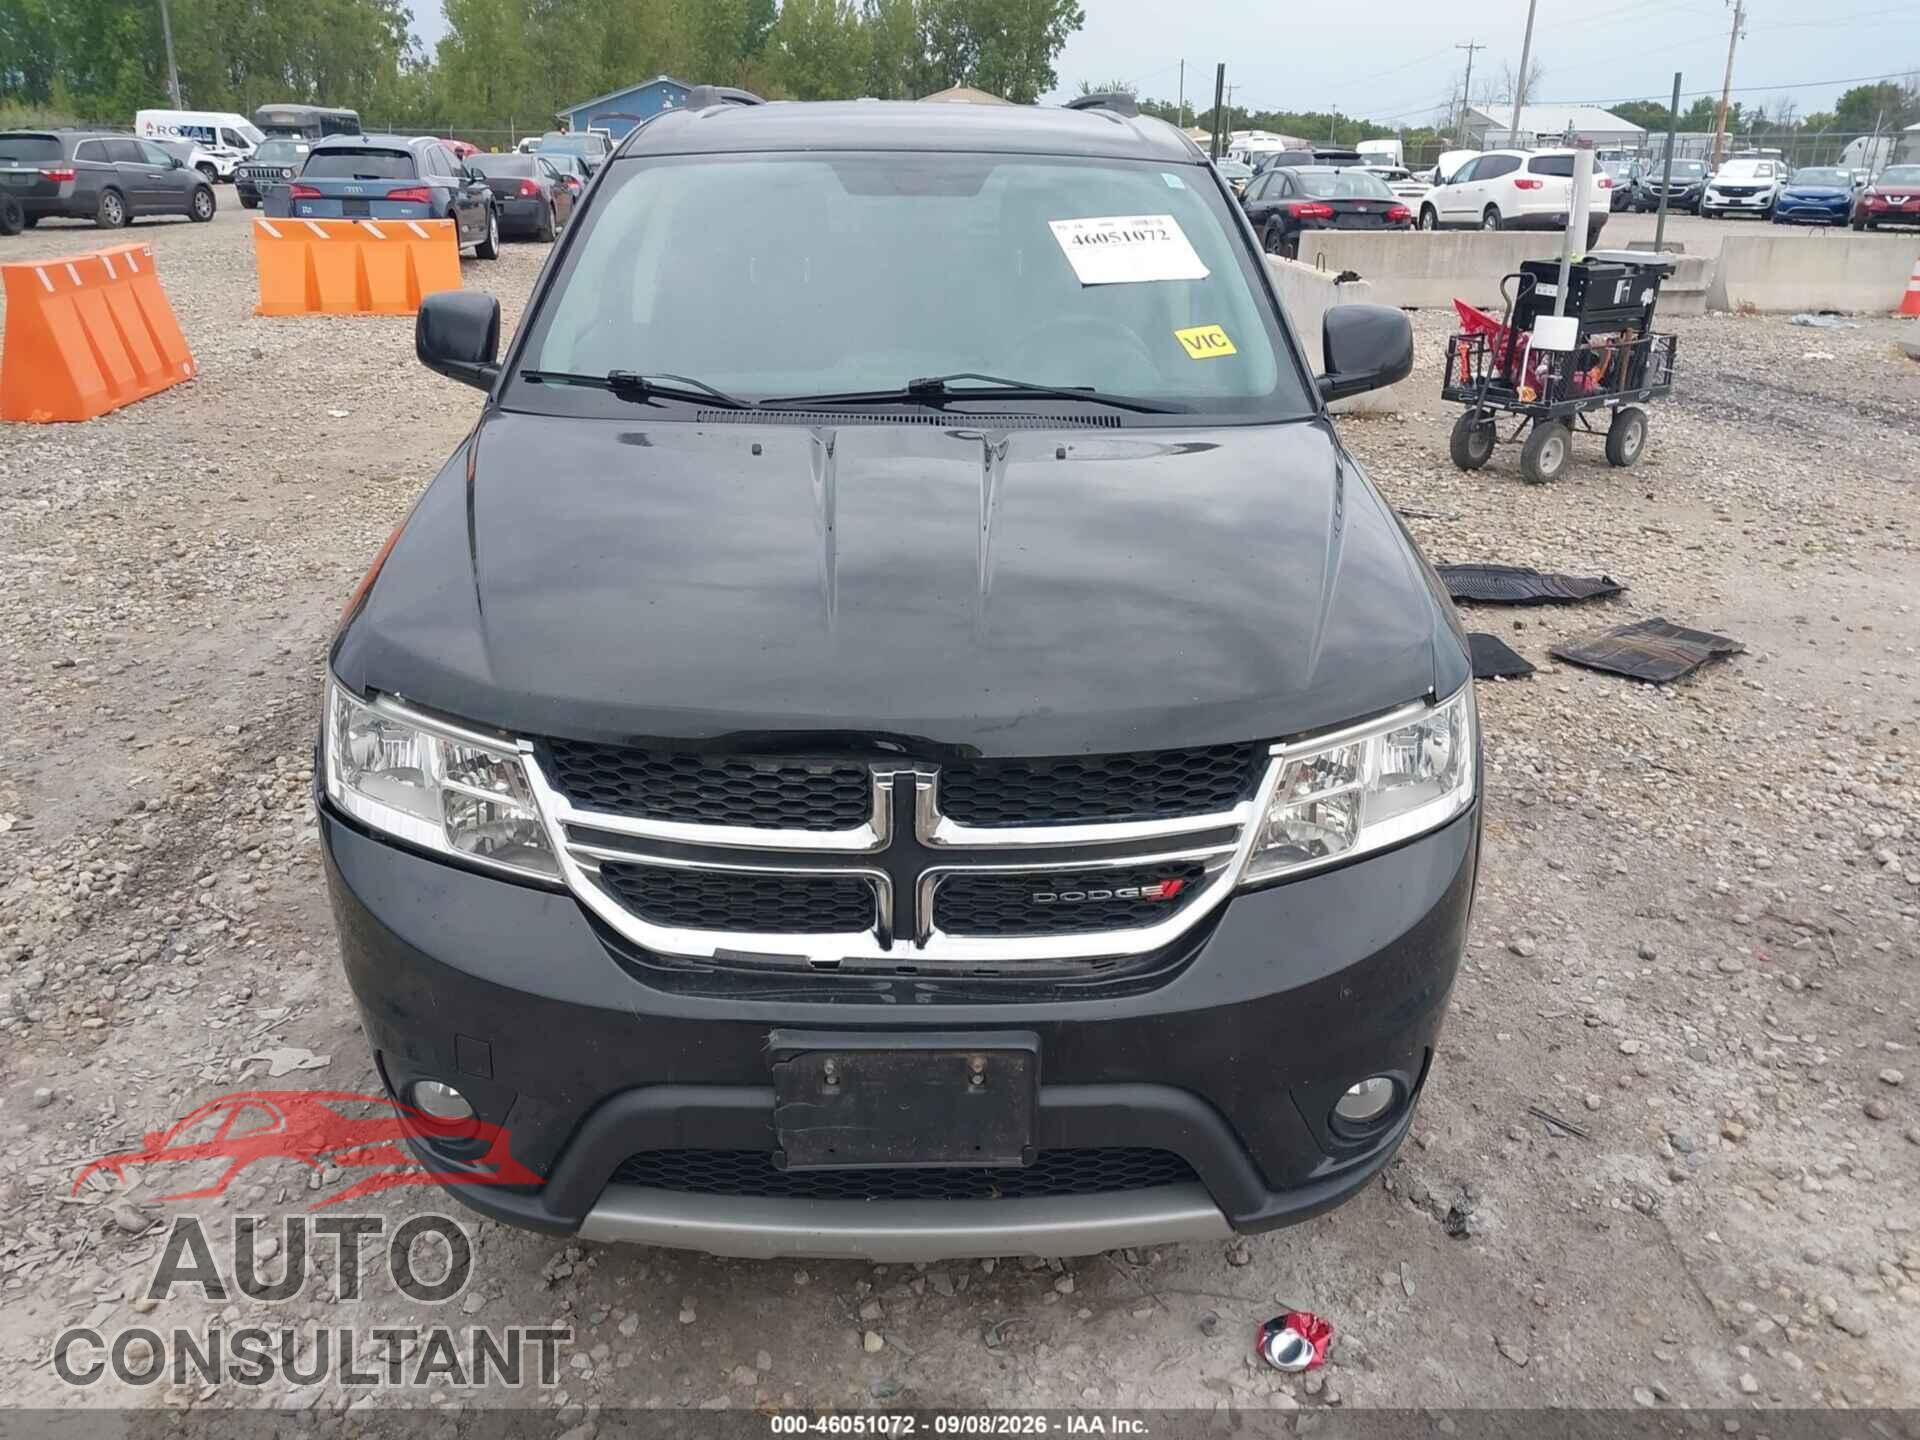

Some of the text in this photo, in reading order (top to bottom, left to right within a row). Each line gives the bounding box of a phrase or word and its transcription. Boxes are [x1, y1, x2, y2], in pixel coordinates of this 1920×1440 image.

[156, 125, 213, 141] ROYAL
[1072, 229, 1171, 246] 46051072
[1183, 332, 1228, 352] VIC
[1032, 885, 1164, 904] DODGE
